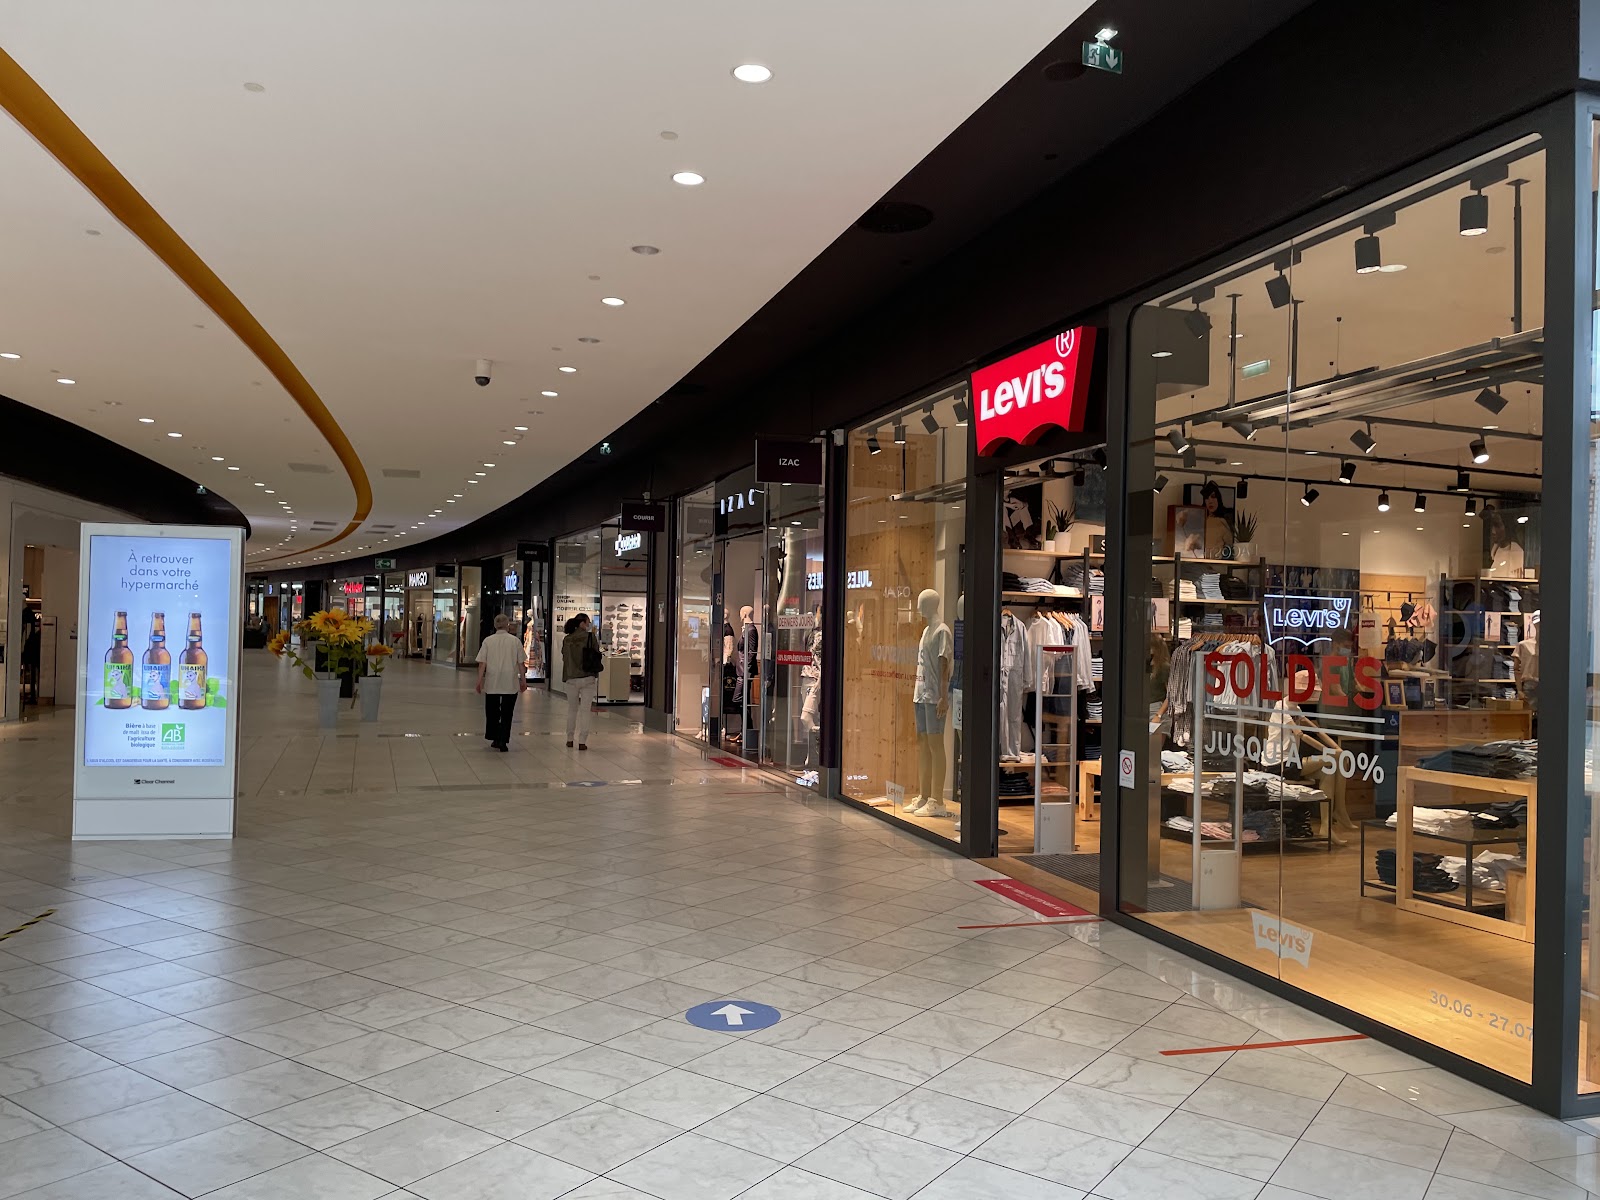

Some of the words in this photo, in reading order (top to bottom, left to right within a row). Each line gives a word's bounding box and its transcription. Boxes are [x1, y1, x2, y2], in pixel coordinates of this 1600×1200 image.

[779, 458, 800, 466] IZAC
[720, 489, 755, 514] IZAC
[128, 549, 137, 562] À
[141, 554, 194, 564] retrouver
[130, 565, 158, 576] dans
[162, 568, 191, 577] votre
[121, 577, 199, 592] hypermarché
[408, 571, 428, 587] MANGO
[778, 617, 798, 627] DERNIERS
[1204, 652, 1384, 710] SOLDES
[162, 729, 181, 741] AB
[1204, 731, 1302, 770] JUSQUÀ
[1310, 747, 1385, 784] -50%
[1430, 990, 1473, 1018] 30.06
[1489, 1013, 1534, 1041] 27.07
